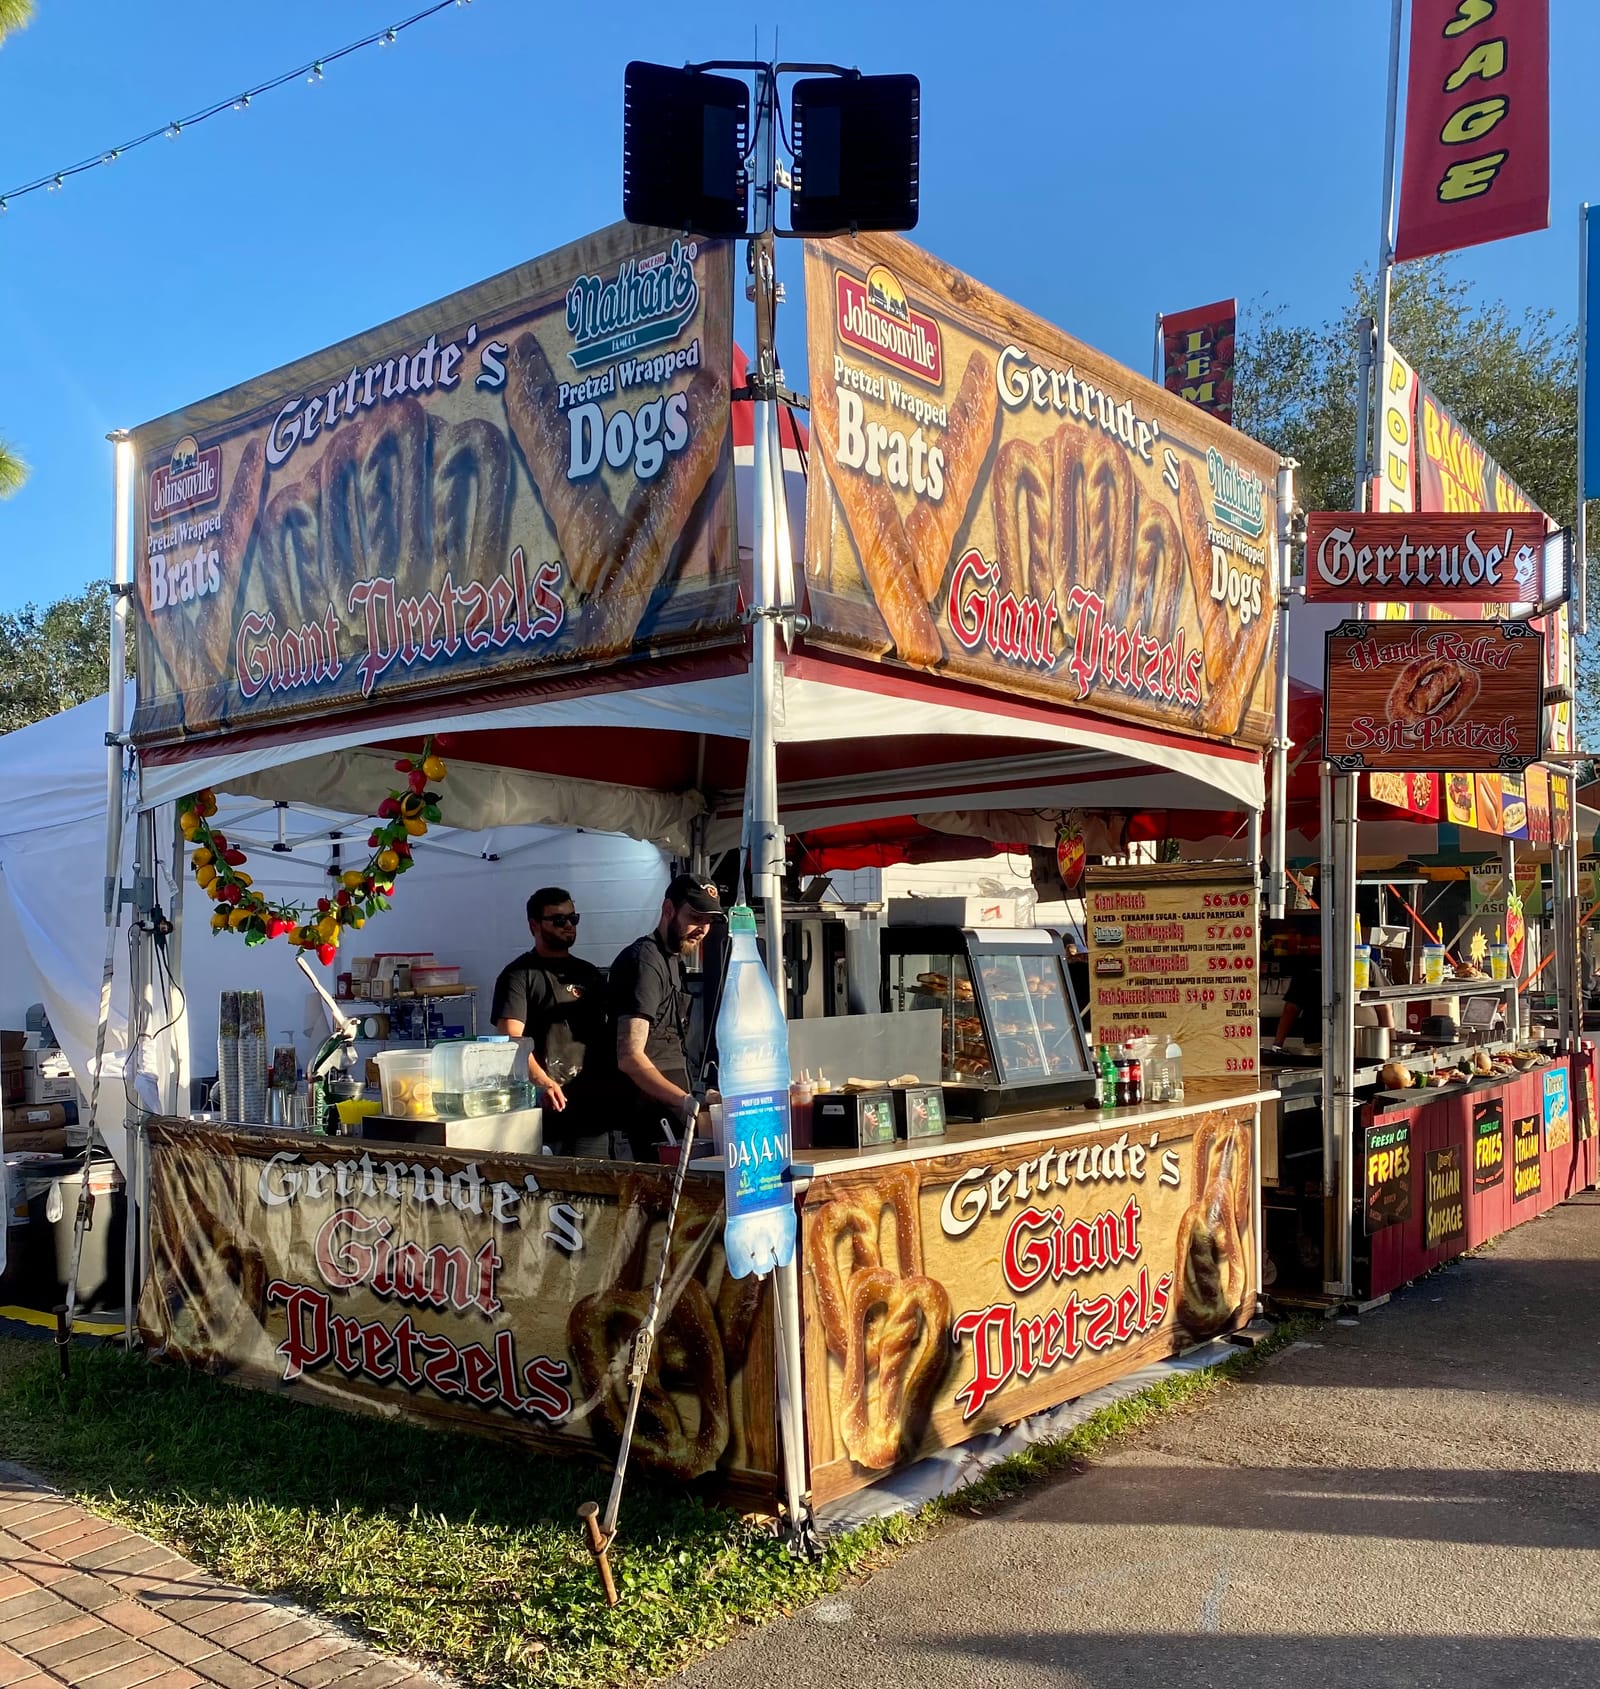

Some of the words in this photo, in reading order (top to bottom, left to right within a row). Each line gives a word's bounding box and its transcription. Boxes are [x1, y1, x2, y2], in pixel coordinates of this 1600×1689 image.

[566, 239, 694, 343] Nathan's
[843, 298, 939, 374] Johnsonville
[264, 324, 509, 465] Gertrude's
[557, 365, 616, 408] Pretzel
[619, 338, 699, 388] Wrapped
[833, 353, 885, 399] Pretzel
[887, 378, 947, 428] Wrapped
[567, 392, 688, 479] Dogs
[996, 344, 1180, 490] Gertrude's
[836, 386, 945, 501] Brats
[153, 462, 215, 511] Johnsonville
[148, 524, 178, 555] Pretzel
[179, 514, 221, 541] Wrapped
[1207, 522, 1233, 550] Pretzel
[1234, 534, 1265, 565] Wrapped
[1317, 527, 1536, 587] Gertrude's
[148, 549, 221, 611] Brats
[1211, 544, 1262, 624] Dogs
[236, 604, 345, 698] Giant
[349, 546, 565, 698] Pretzels
[949, 548, 1058, 670] Giant
[1066, 585, 1202, 707] Pretzels
[1346, 626, 1427, 672] Hand
[1426, 632, 1523, 672] Rolled
[1346, 717, 1412, 754] Soft
[1413, 716, 1519, 754] Pretzels
[1093, 914, 1116, 922] SALTED
[1121, 913, 1153, 921] CINNAMON
[1156, 913, 1176, 921] SUGAR
[1182, 912, 1205, 920] GARLIC
[1206, 911, 1245, 919] PARMESEAN
[1203, 893, 1250, 907] $6.00
[1207, 926, 1253, 940] $7.00
[1208, 957, 1254, 971] $9.00
[1223, 988, 1252, 1002] $7.00
[1224, 1025, 1252, 1038] $3.00
[1226, 1058, 1254, 1071] $3.00
[728, 1130, 788, 1173] DASANI
[1370, 1133, 1394, 1149] FRESH
[1396, 1128, 1408, 1141] CUT
[1476, 1132, 1503, 1170] FRIES
[1515, 1133, 1539, 1164] ITALIAN
[940, 1132, 1181, 1236] Gertrude's
[1368, 1146, 1410, 1186] FRIES
[1429, 1169, 1460, 1202] ITALIAN
[1515, 1164, 1540, 1197] SAUSAGE
[257, 1151, 584, 1252] Gertrude's
[1428, 1204, 1463, 1241] SAUSAGE
[314, 1206, 503, 1316] Giant
[1003, 1194, 1141, 1293] Giant
[267, 1278, 572, 1423] Pretzels
[952, 1264, 1175, 1420] Pretzels
